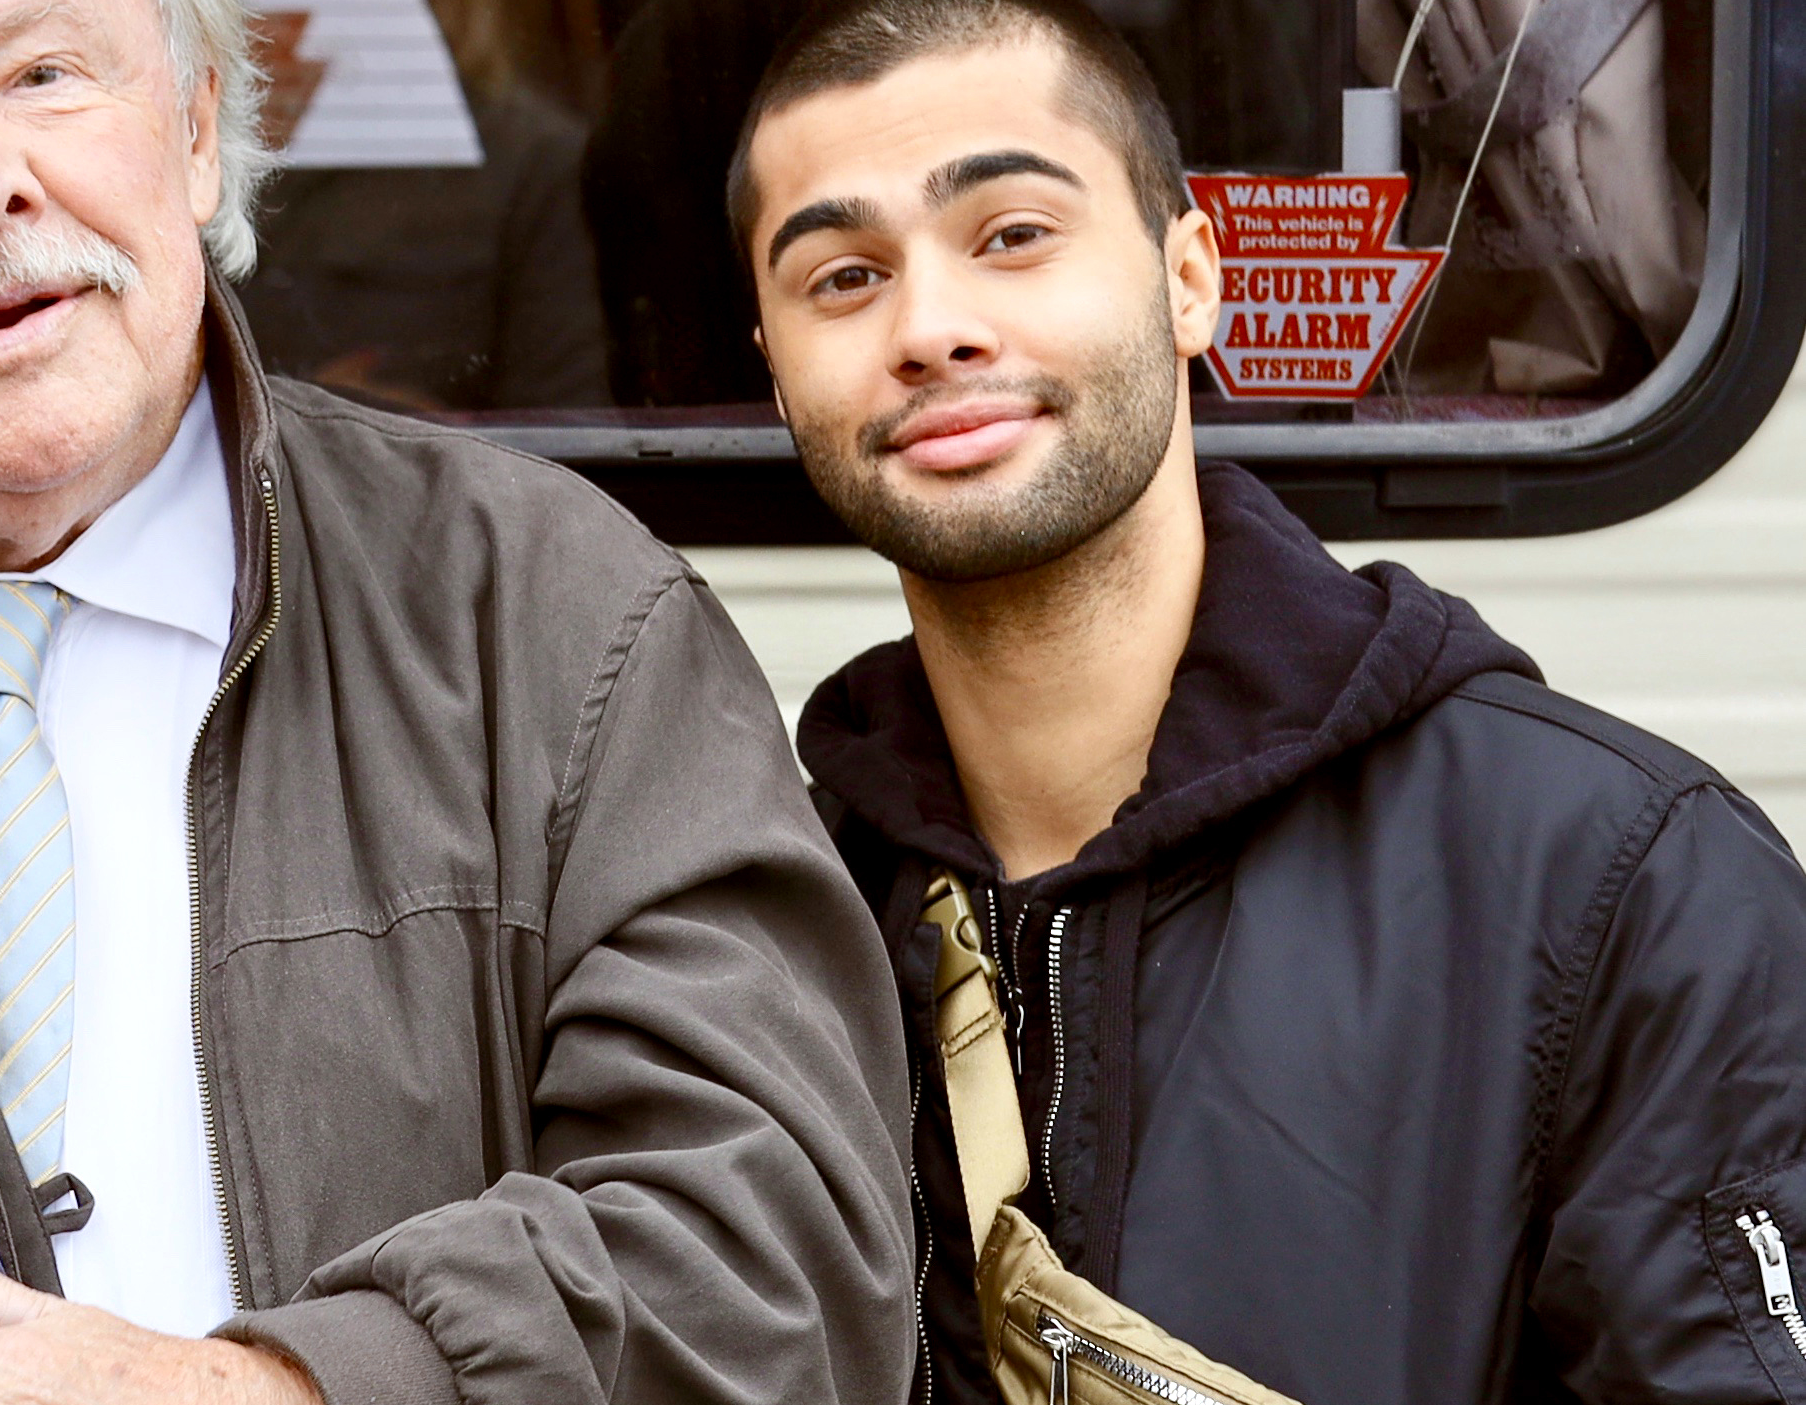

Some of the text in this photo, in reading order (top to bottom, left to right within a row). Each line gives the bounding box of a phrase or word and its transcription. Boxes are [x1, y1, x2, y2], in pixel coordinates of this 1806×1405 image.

[1225, 185, 1370, 208] WARNING
[1233, 215, 1364, 232] This vehicle is
[1239, 234, 1360, 252] protected by
[1220, 267, 1397, 303] ECURITY
[1225, 313, 1371, 349] ALARM
[1240, 358, 1353, 381] SYSTEMS
